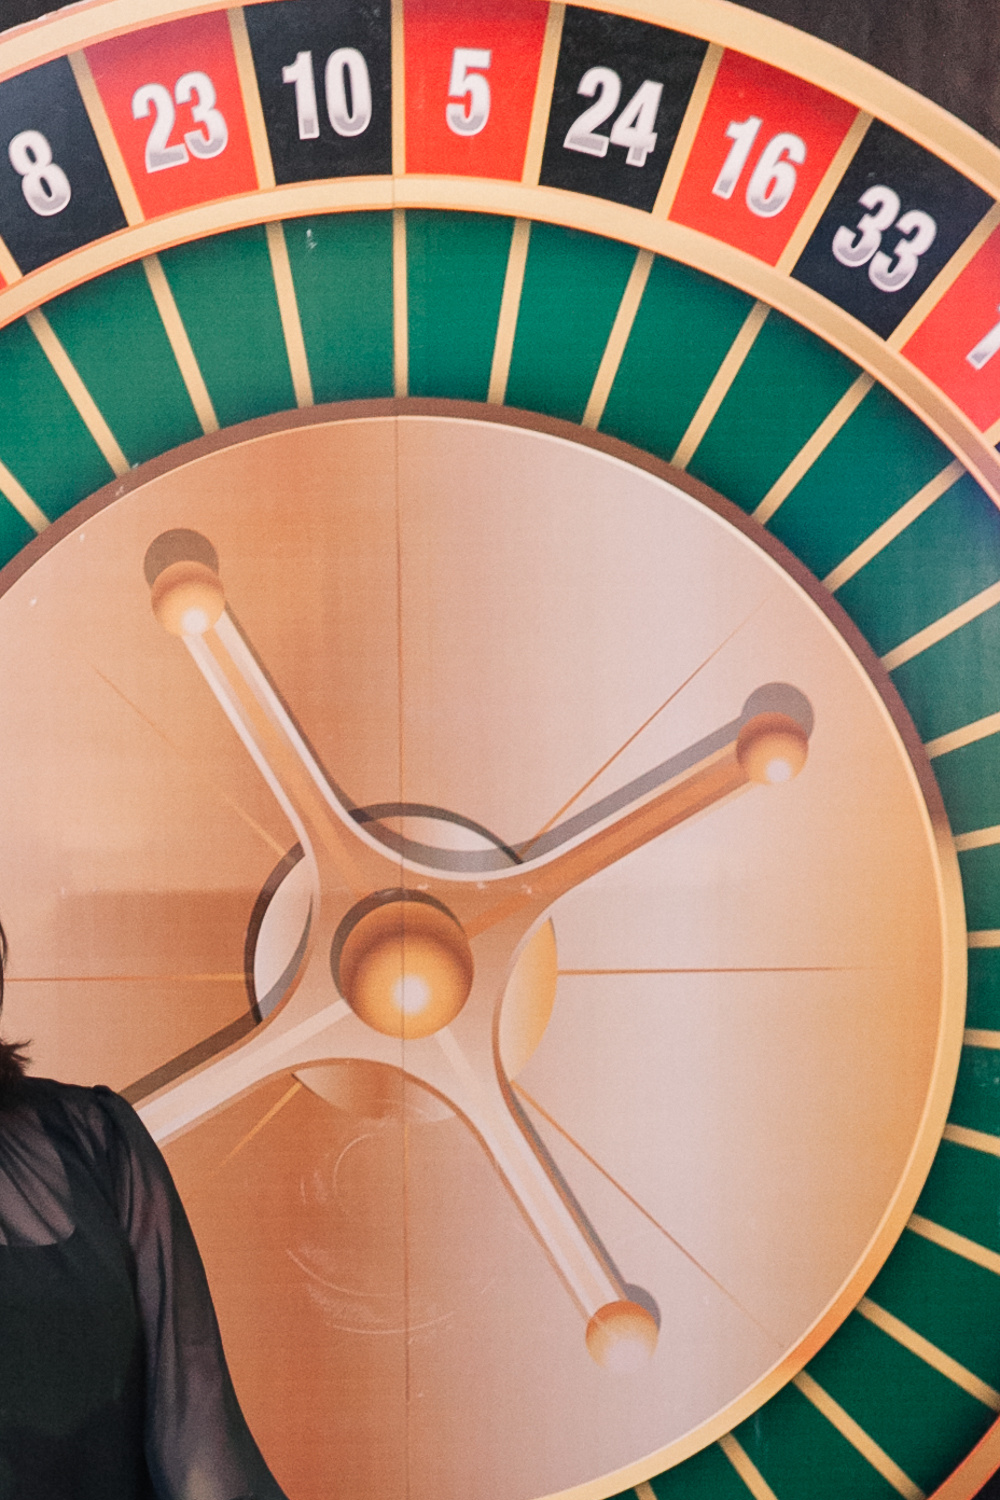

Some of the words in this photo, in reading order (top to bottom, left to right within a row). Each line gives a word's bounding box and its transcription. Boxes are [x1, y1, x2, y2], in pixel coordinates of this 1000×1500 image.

[130, 70, 230, 174] 23
[280, 46, 374, 141] 10
[444, 46, 493, 138] 5
[562, 66, 664, 168] 24
[8, 129, 72, 217] 8
[711, 115, 807, 219] 16
[831, 185, 938, 293] 33
